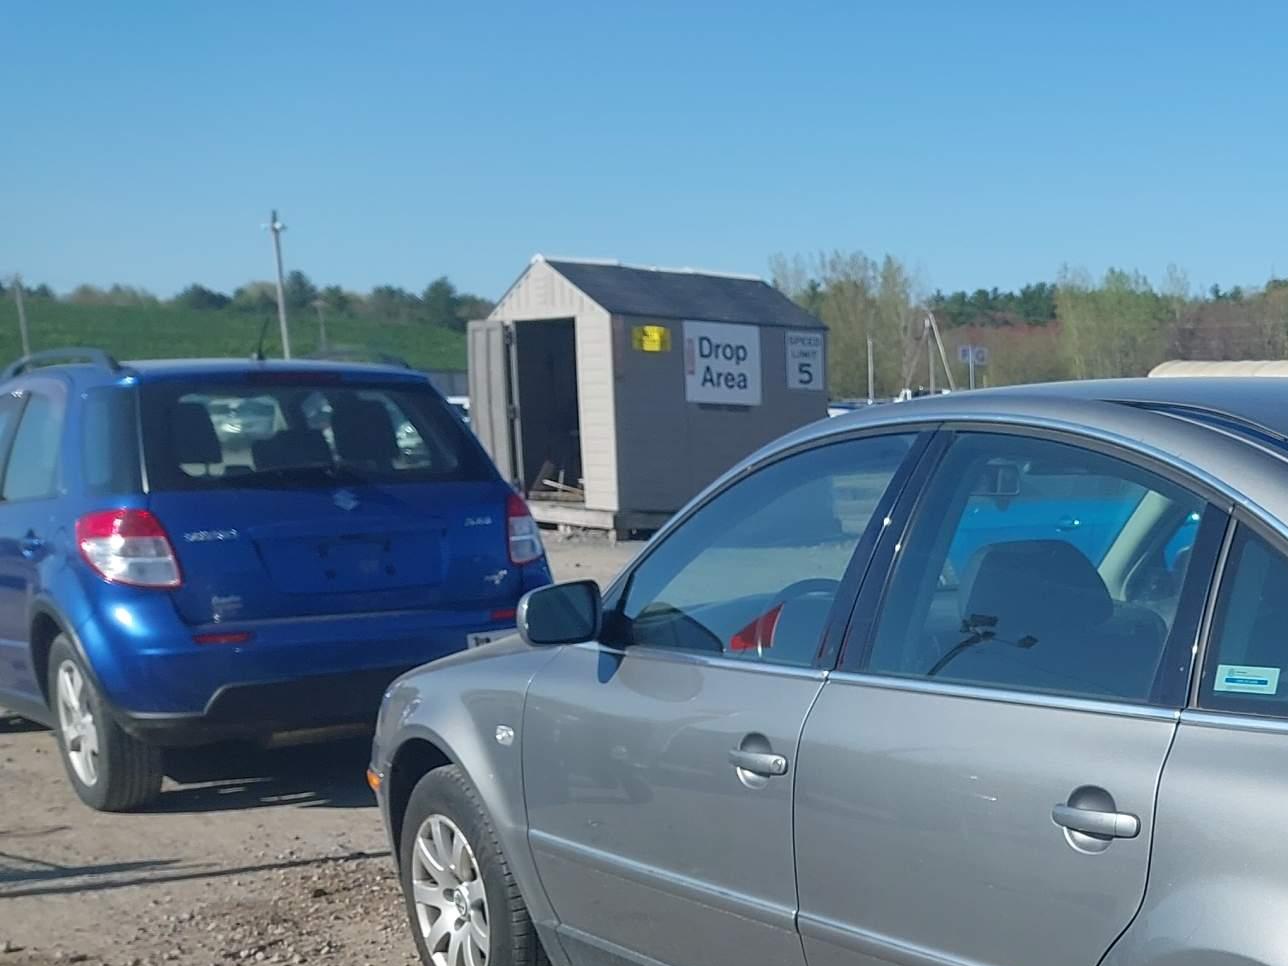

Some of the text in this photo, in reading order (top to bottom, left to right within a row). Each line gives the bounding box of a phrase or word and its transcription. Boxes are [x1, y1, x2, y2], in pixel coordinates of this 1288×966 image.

[699, 336, 748, 366] Drop
[790, 336, 820, 347] SPEED
[701, 365, 748, 390] Area
[799, 363, 813, 385] 5
